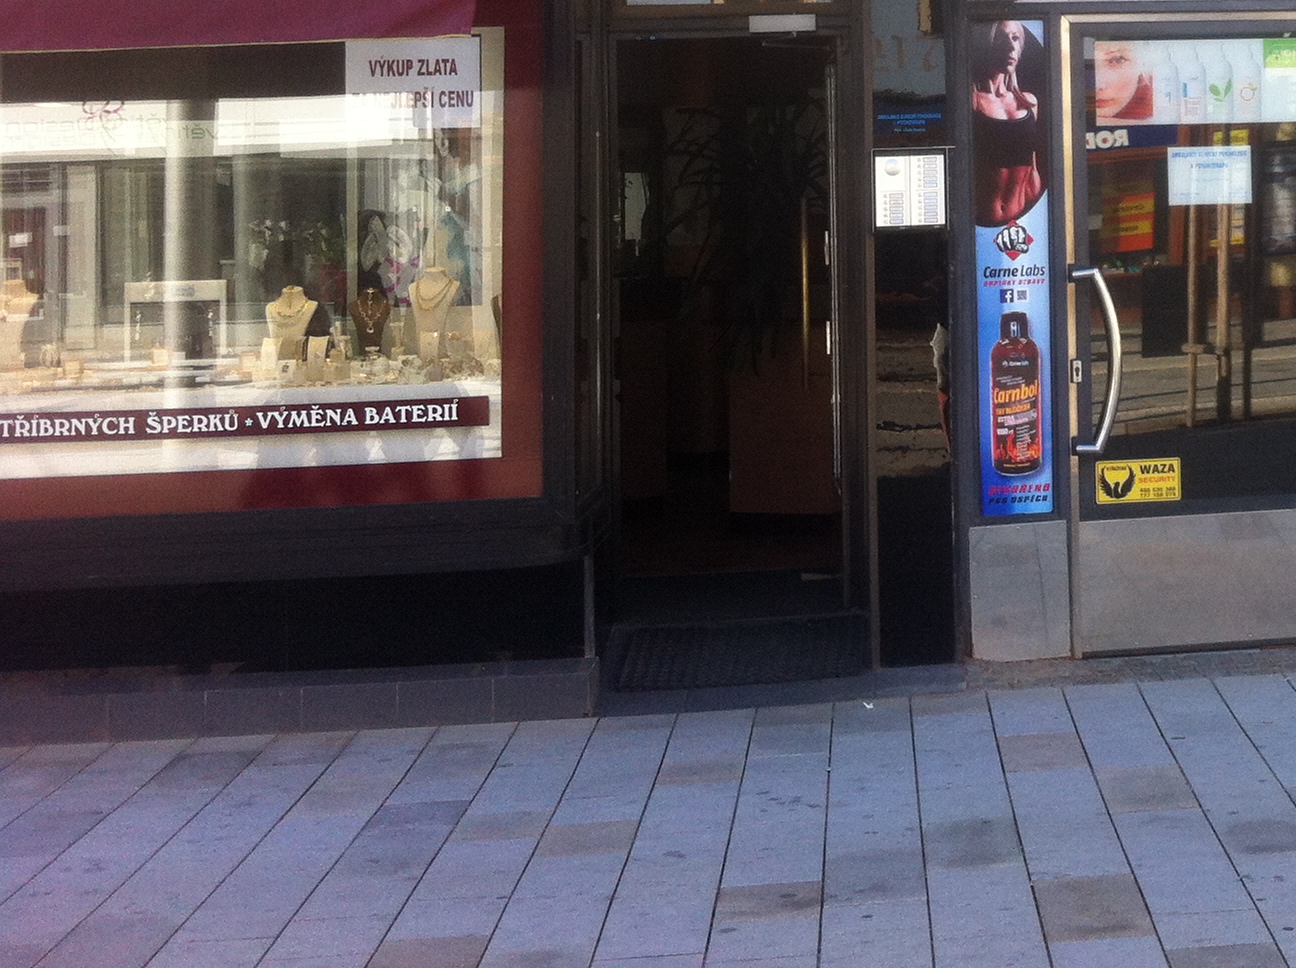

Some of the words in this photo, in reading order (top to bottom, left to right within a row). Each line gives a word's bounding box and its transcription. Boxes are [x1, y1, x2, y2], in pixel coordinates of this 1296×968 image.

[369, 55, 414, 77] VÝKUP
[416, 58, 458, 76] ZLATA
[438, 90, 475, 109] CENU
[983, 266, 1018, 279] Carne
[1020, 264, 1046, 277] Labs
[1, 413, 135, 438] TŘÍBRNÝCH
[146, 409, 239, 434] ŠPERKŮ
[256, 405, 358, 430] VÝMĚNA
[364, 399, 459, 425] BATERIÍ
[1139, 463, 1175, 474] WAZA
